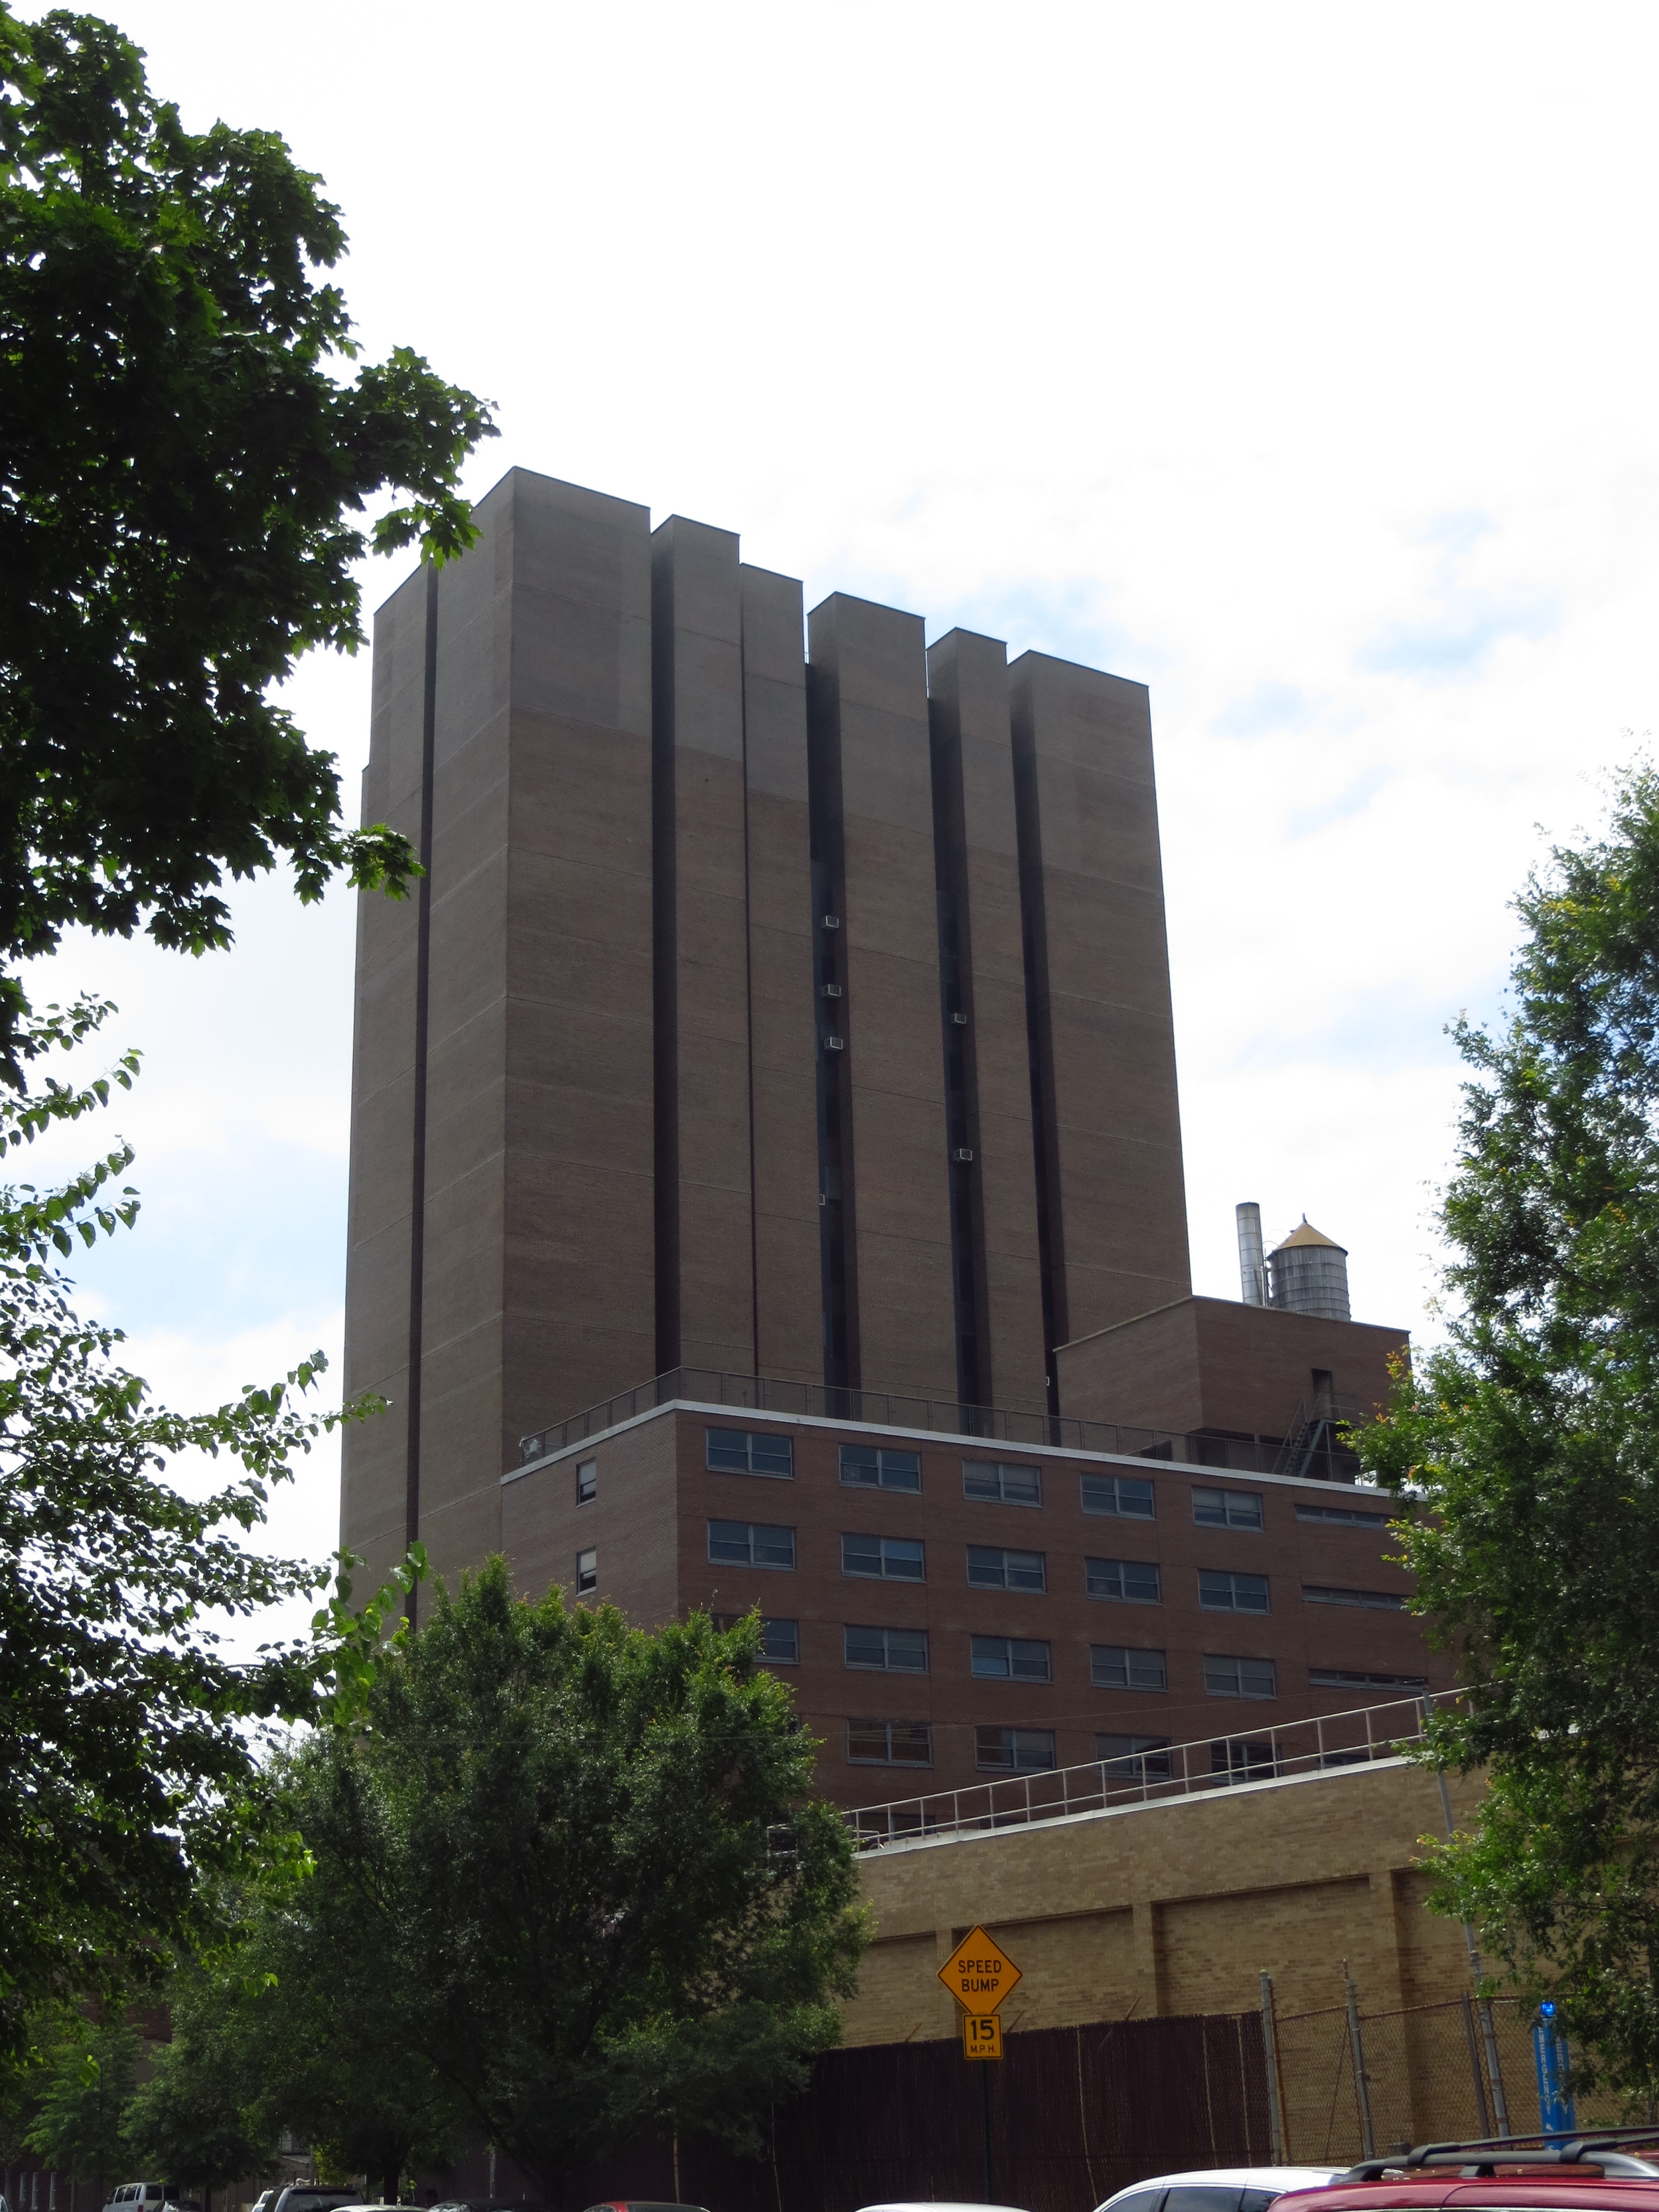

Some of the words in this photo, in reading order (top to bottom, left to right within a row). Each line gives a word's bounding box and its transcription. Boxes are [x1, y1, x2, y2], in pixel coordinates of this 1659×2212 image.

[958, 1960, 1001, 1973] SPEED
[962, 1979, 999, 1992] BUMP
[970, 2020, 994, 2040] 15
[970, 2045, 997, 2053] M.P.H.
